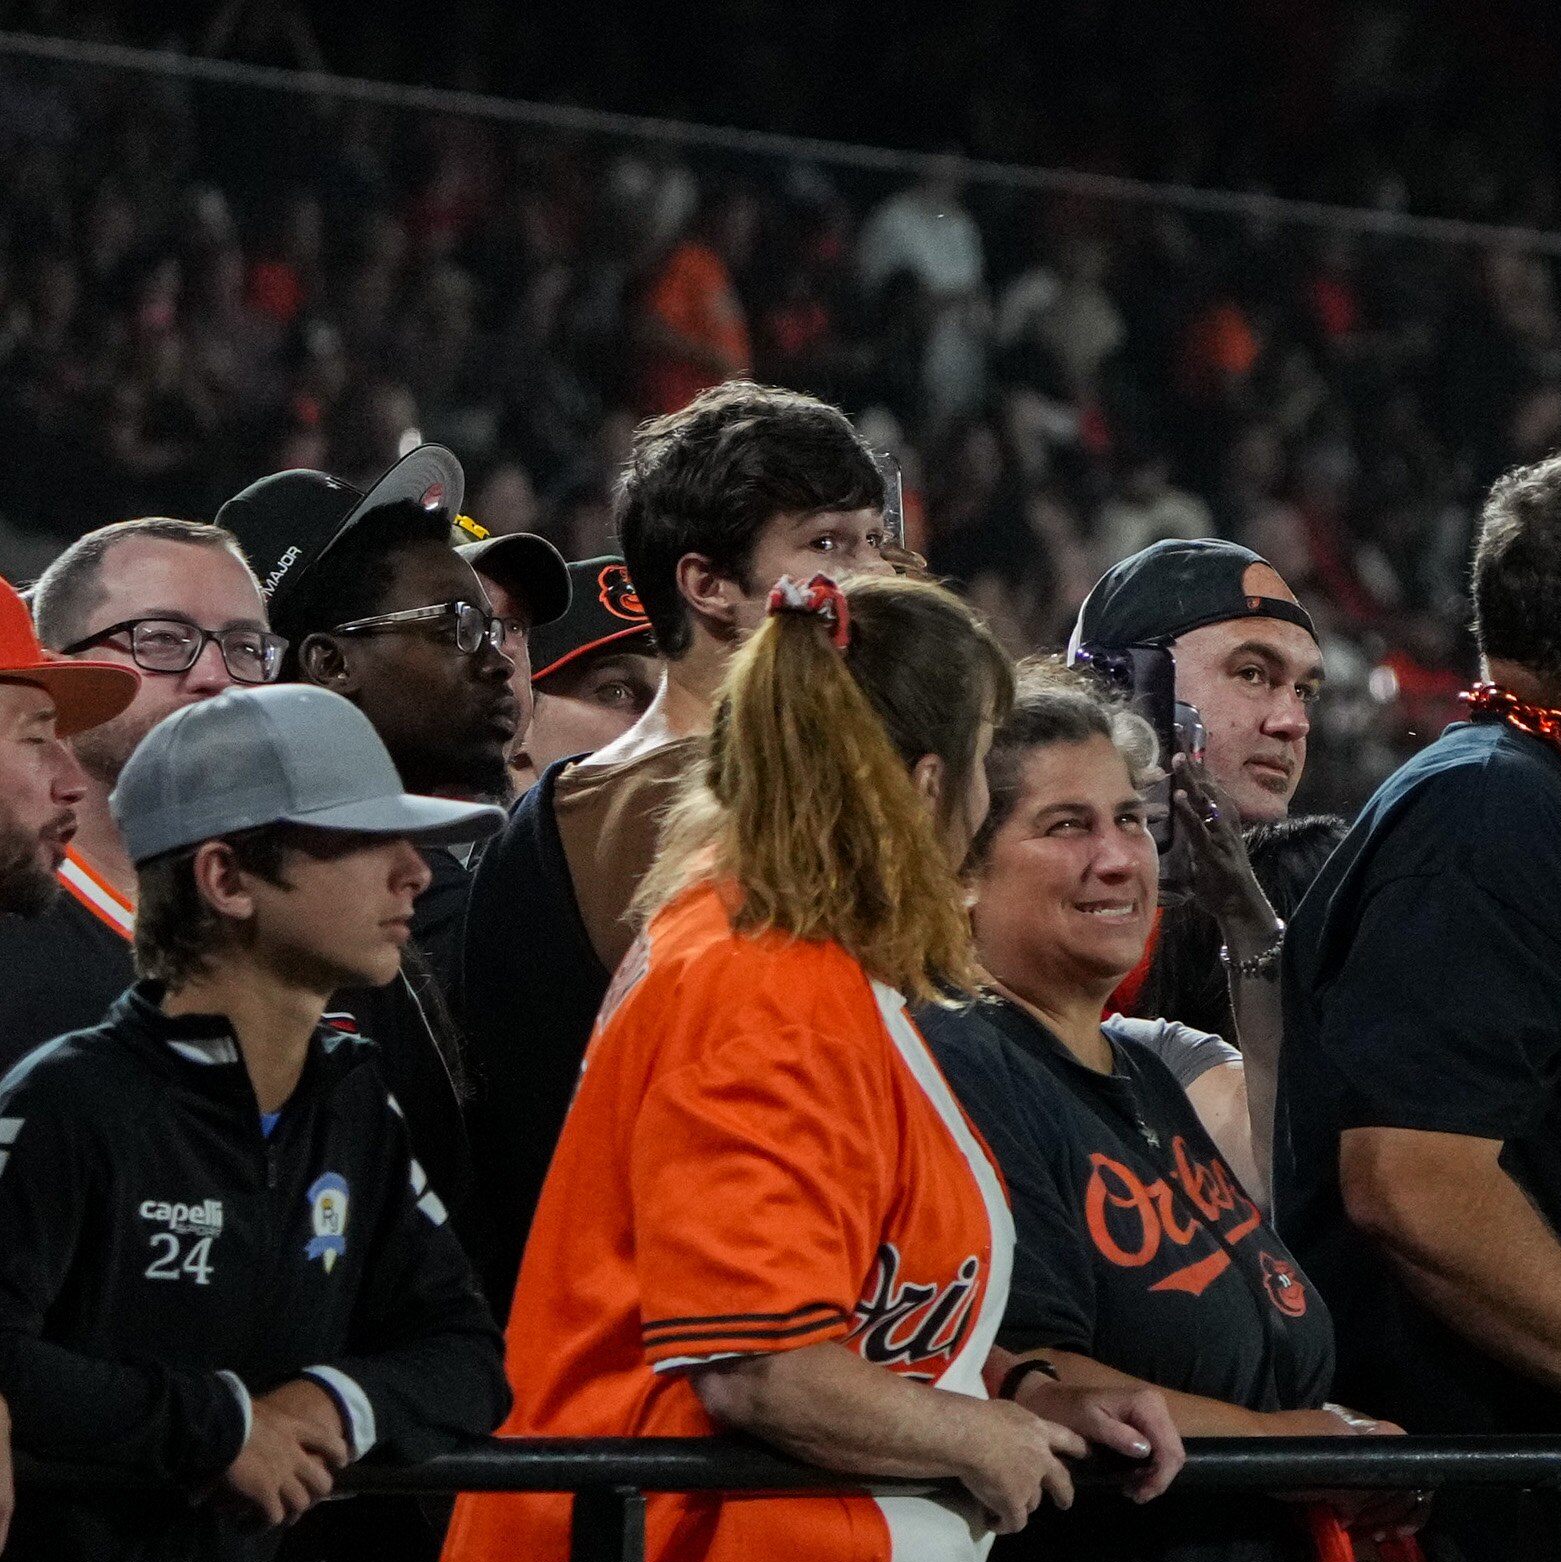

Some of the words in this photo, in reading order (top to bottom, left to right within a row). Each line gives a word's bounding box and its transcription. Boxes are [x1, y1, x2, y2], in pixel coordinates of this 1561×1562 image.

[263, 545, 303, 597] MAJOR
[139, 1198, 223, 1230] capelli
[145, 1232, 214, 1285] 24
